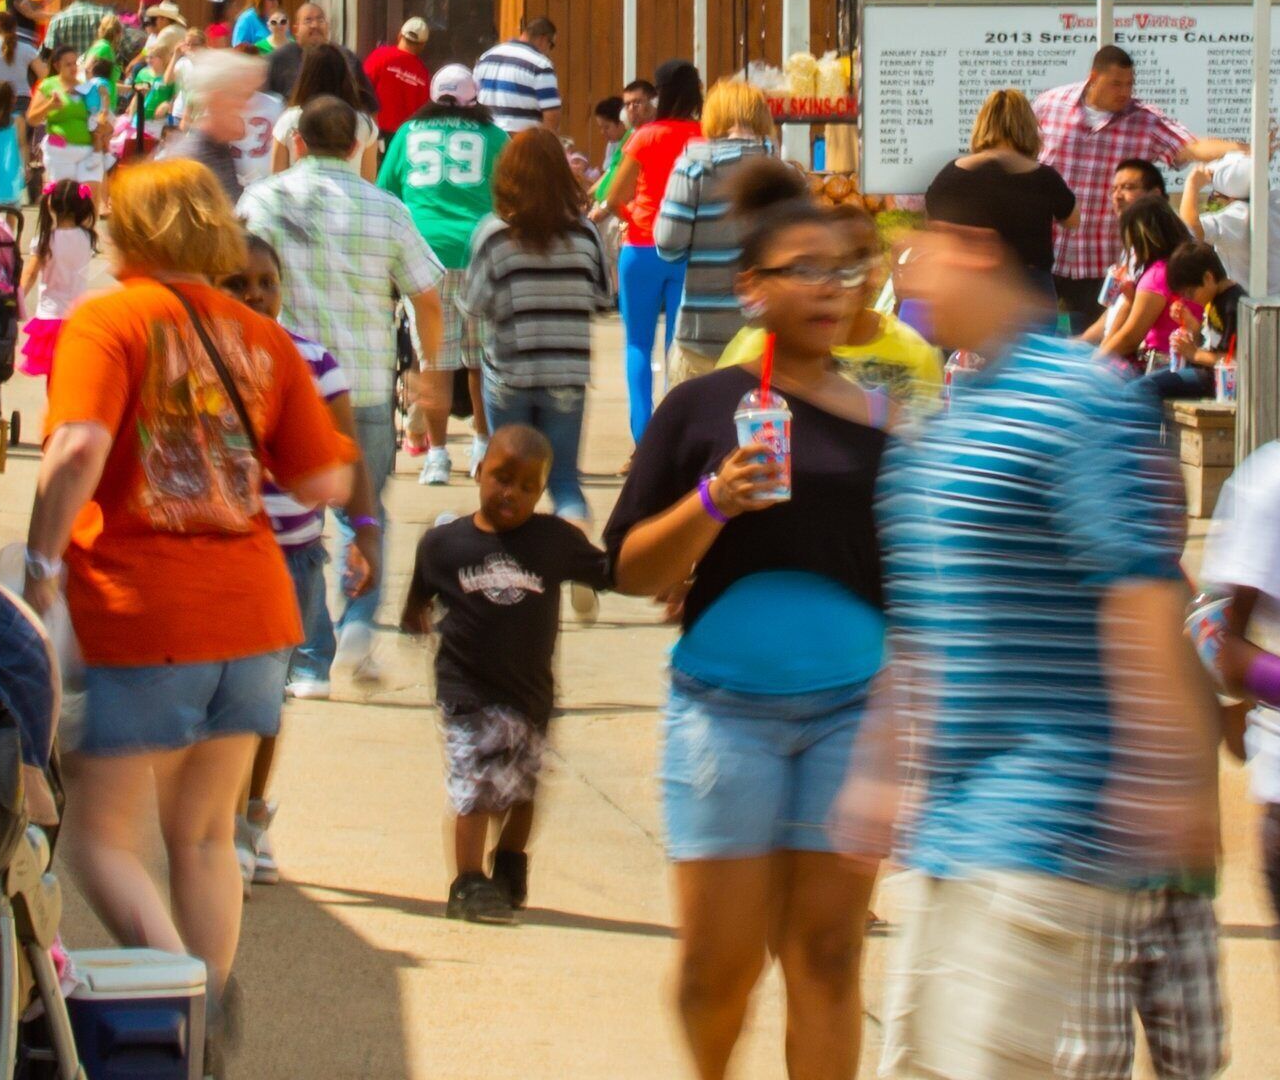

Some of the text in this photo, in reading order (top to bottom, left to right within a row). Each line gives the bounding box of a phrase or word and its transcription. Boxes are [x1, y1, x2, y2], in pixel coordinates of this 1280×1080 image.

[985, 32, 1254, 44] 2013 SPECIA EVENTS CALAND
[406, 130, 487, 188] 59
